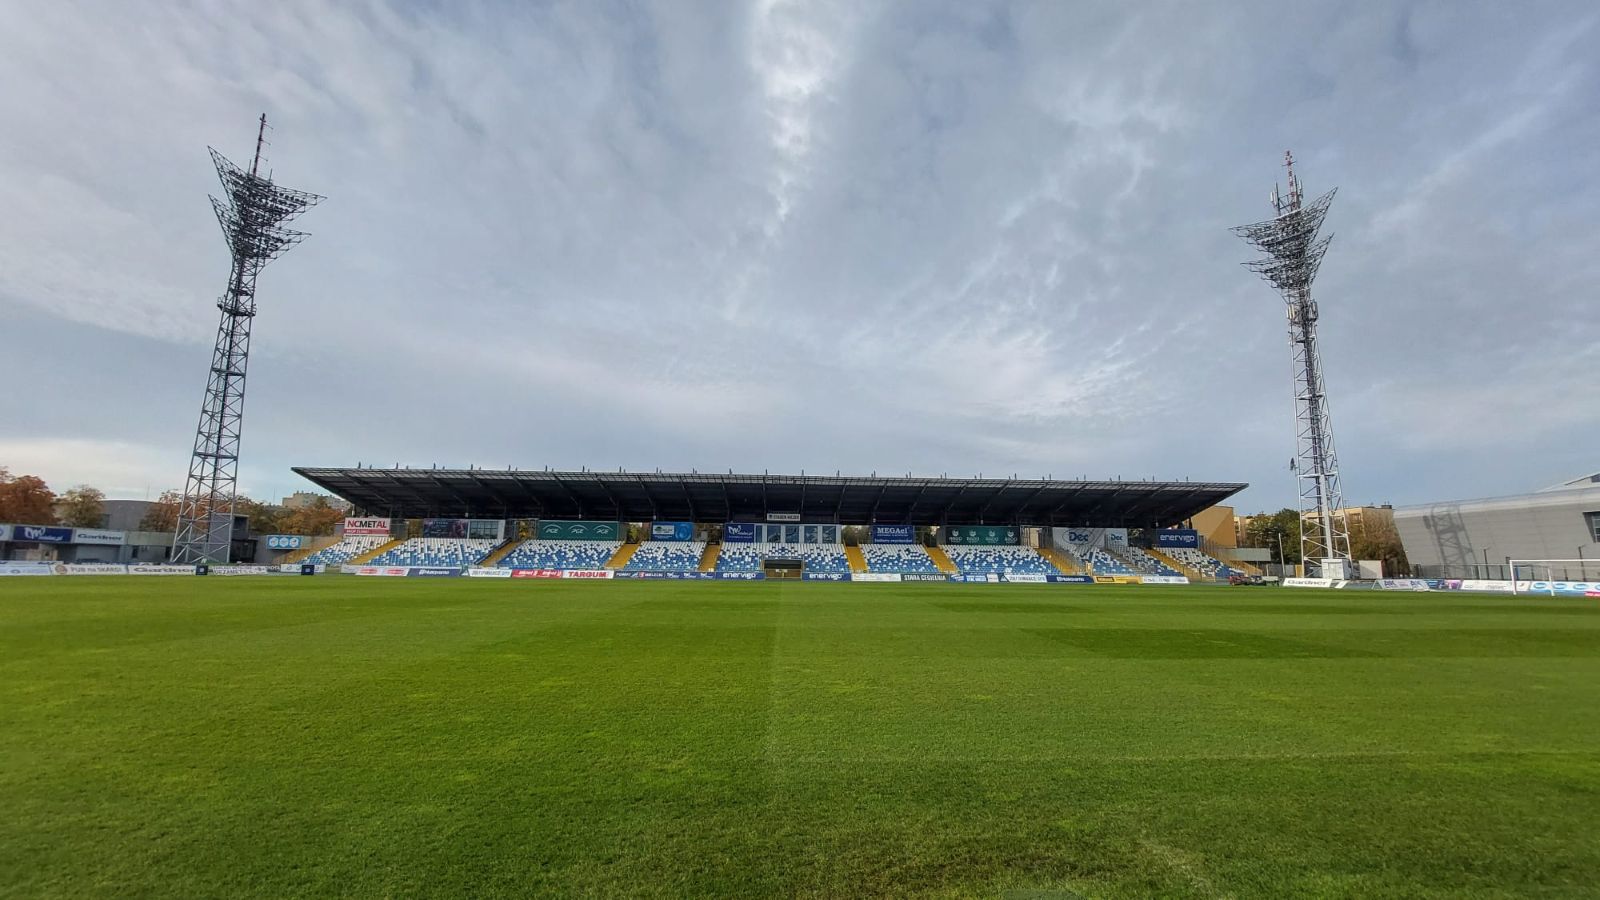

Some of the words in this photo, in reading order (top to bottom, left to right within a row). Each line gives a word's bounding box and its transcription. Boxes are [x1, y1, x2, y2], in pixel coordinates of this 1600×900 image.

[347, 520, 387, 529] NCMETAL
[78, 533, 122, 541] Gardner
[1160, 534, 1195, 542] enervigo
[723, 572, 757, 580] enervigo
[809, 573, 842, 581] enervigo
